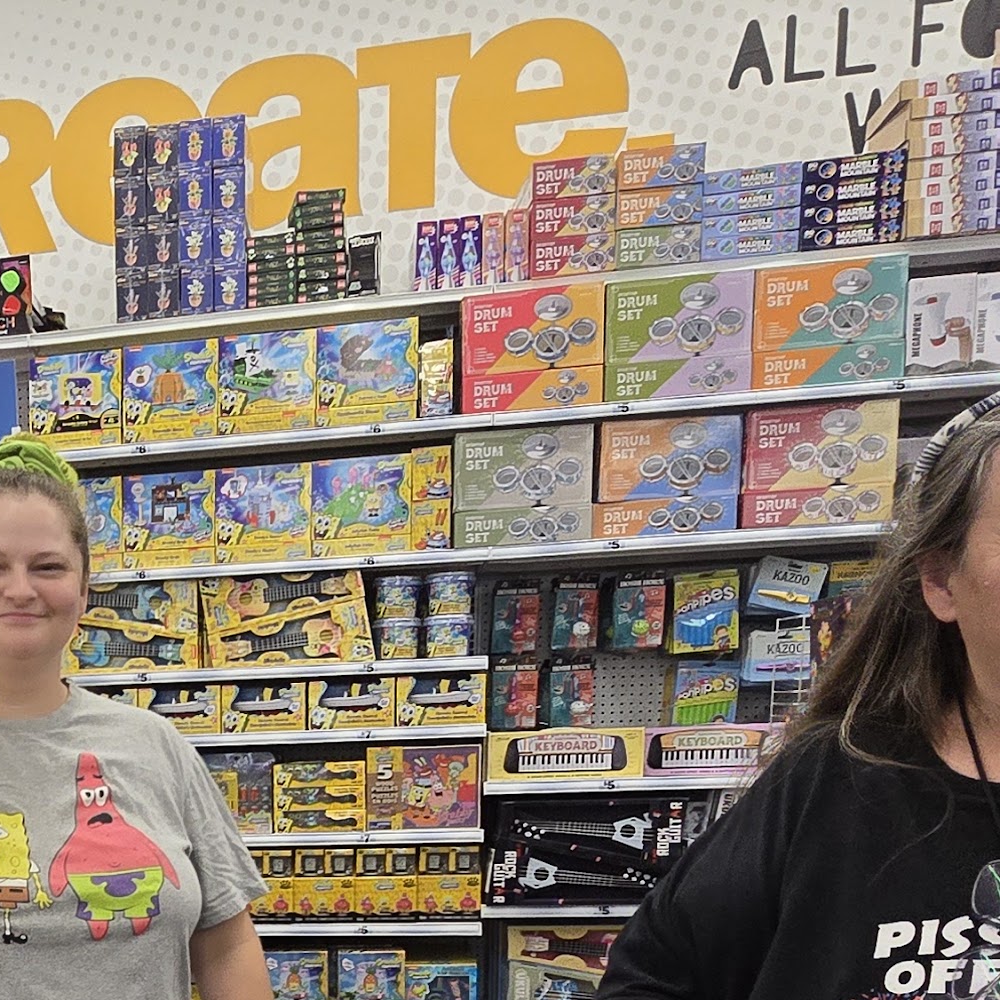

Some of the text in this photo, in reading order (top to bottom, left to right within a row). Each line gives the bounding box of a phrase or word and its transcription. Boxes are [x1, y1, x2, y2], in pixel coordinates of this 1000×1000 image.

[728, 7, 876, 90] ALL
[623, 155, 663, 170] DRUM
[536, 167, 575, 182] DRUM
[623, 171, 649, 184] SET
[536, 182, 561, 195] SET
[621, 196, 660, 211] DRUM
[535, 206, 575, 221] DRUM
[620, 211, 646, 224] SET
[535, 220, 560, 233] SET
[620, 236, 660, 250] DRUM
[535, 244, 575, 259] DRUM
[620, 250, 645, 263] SET
[535, 259, 560, 272] SET
[766, 279, 808, 295] DRUM
[617, 294, 658, 309] DRUM
[766, 295, 793, 307] SET
[474, 305, 512, 320] DRUM
[617, 309, 643, 322] SET
[474, 321, 498, 333] SET
[911, 312, 924, 358] MEGAPHONE
[764, 358, 806, 373] DRUM
[617, 369, 657, 384] DRUM
[764, 373, 791, 386] SET
[473, 382, 512, 397] DRUM
[617, 384, 642, 397] SET
[473, 397, 498, 410] SET
[758, 421, 801, 437] DRUM
[611, 434, 650, 448] DRUM
[758, 436, 786, 449] SET
[465, 445, 503, 458] DRUM
[610, 448, 637, 460] SET
[465, 459, 490, 471] SET
[755, 497, 797, 512] DRUM
[603, 510, 643, 523] DRUM
[755, 511, 782, 524] SET
[465, 519, 503, 532] DRUM
[603, 523, 629, 536] SET
[465, 532, 489, 544] SET
[772, 568, 810, 586] KAZOO
[534, 740, 598, 751] KEYBOARD
[677, 735, 743, 747] KEYBOARD
[376, 764, 394, 781] 5
[656, 801, 683, 857] ROCK GUITAR
[492, 850, 517, 904] ROCK GUITAR
